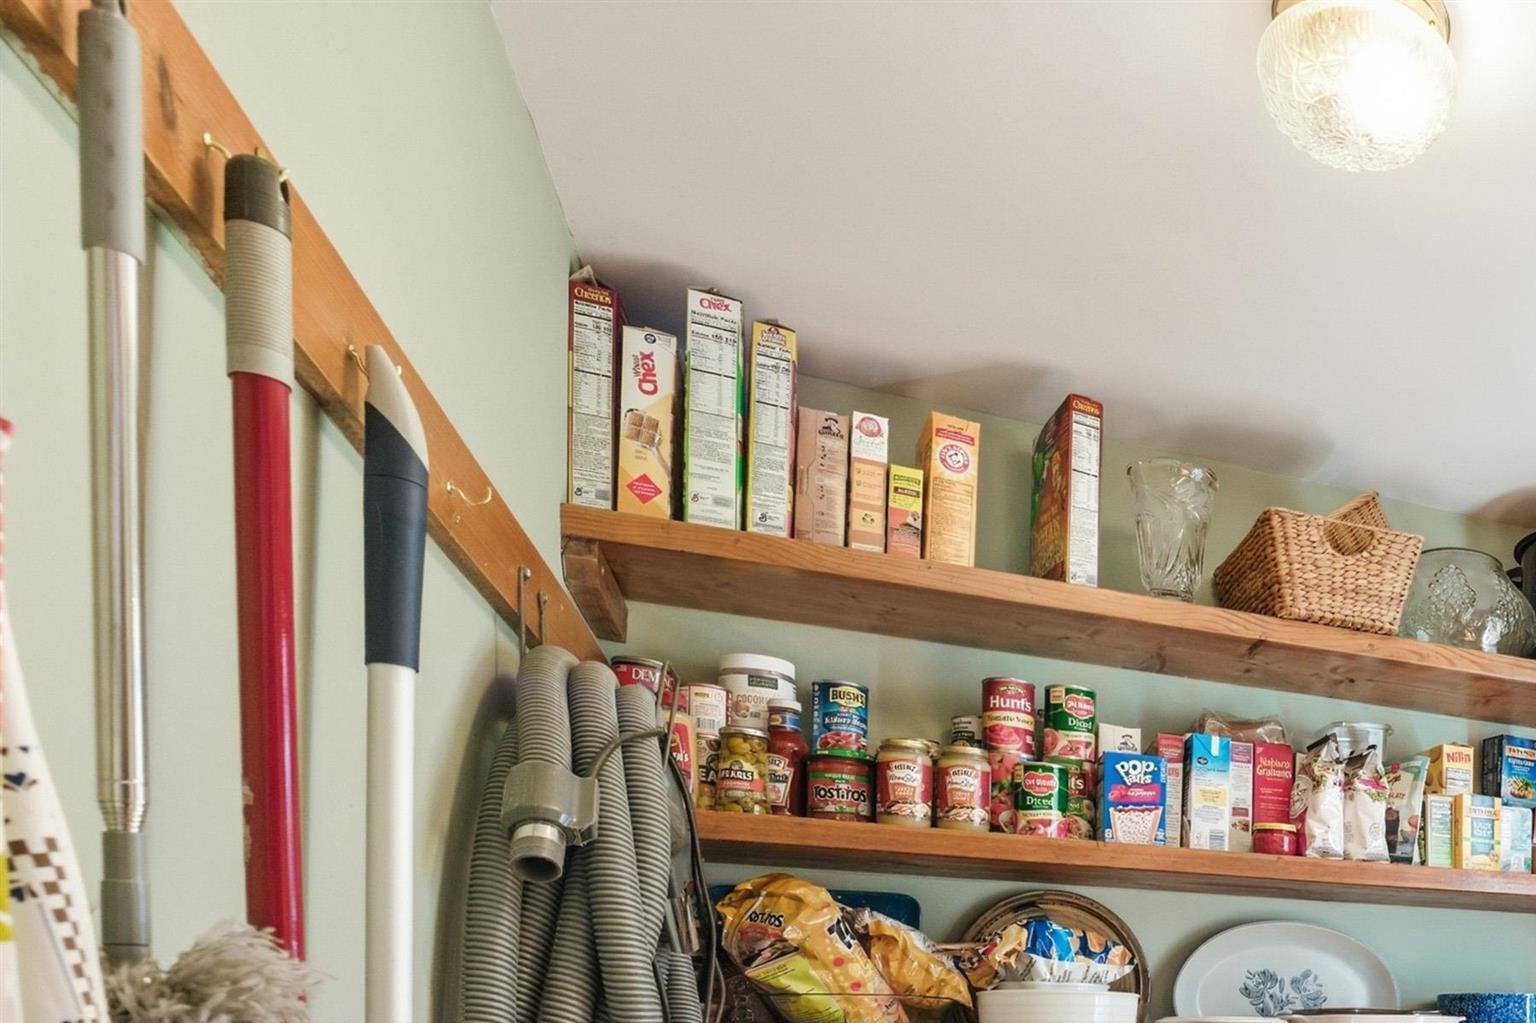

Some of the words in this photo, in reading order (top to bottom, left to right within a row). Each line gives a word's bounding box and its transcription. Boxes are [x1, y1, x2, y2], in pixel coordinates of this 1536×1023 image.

[699, 297, 732, 312] Chex
[637, 351, 659, 396] Chex
[989, 694, 1032, 713] Hunt's
[1446, 751, 1471, 763] Nilla
